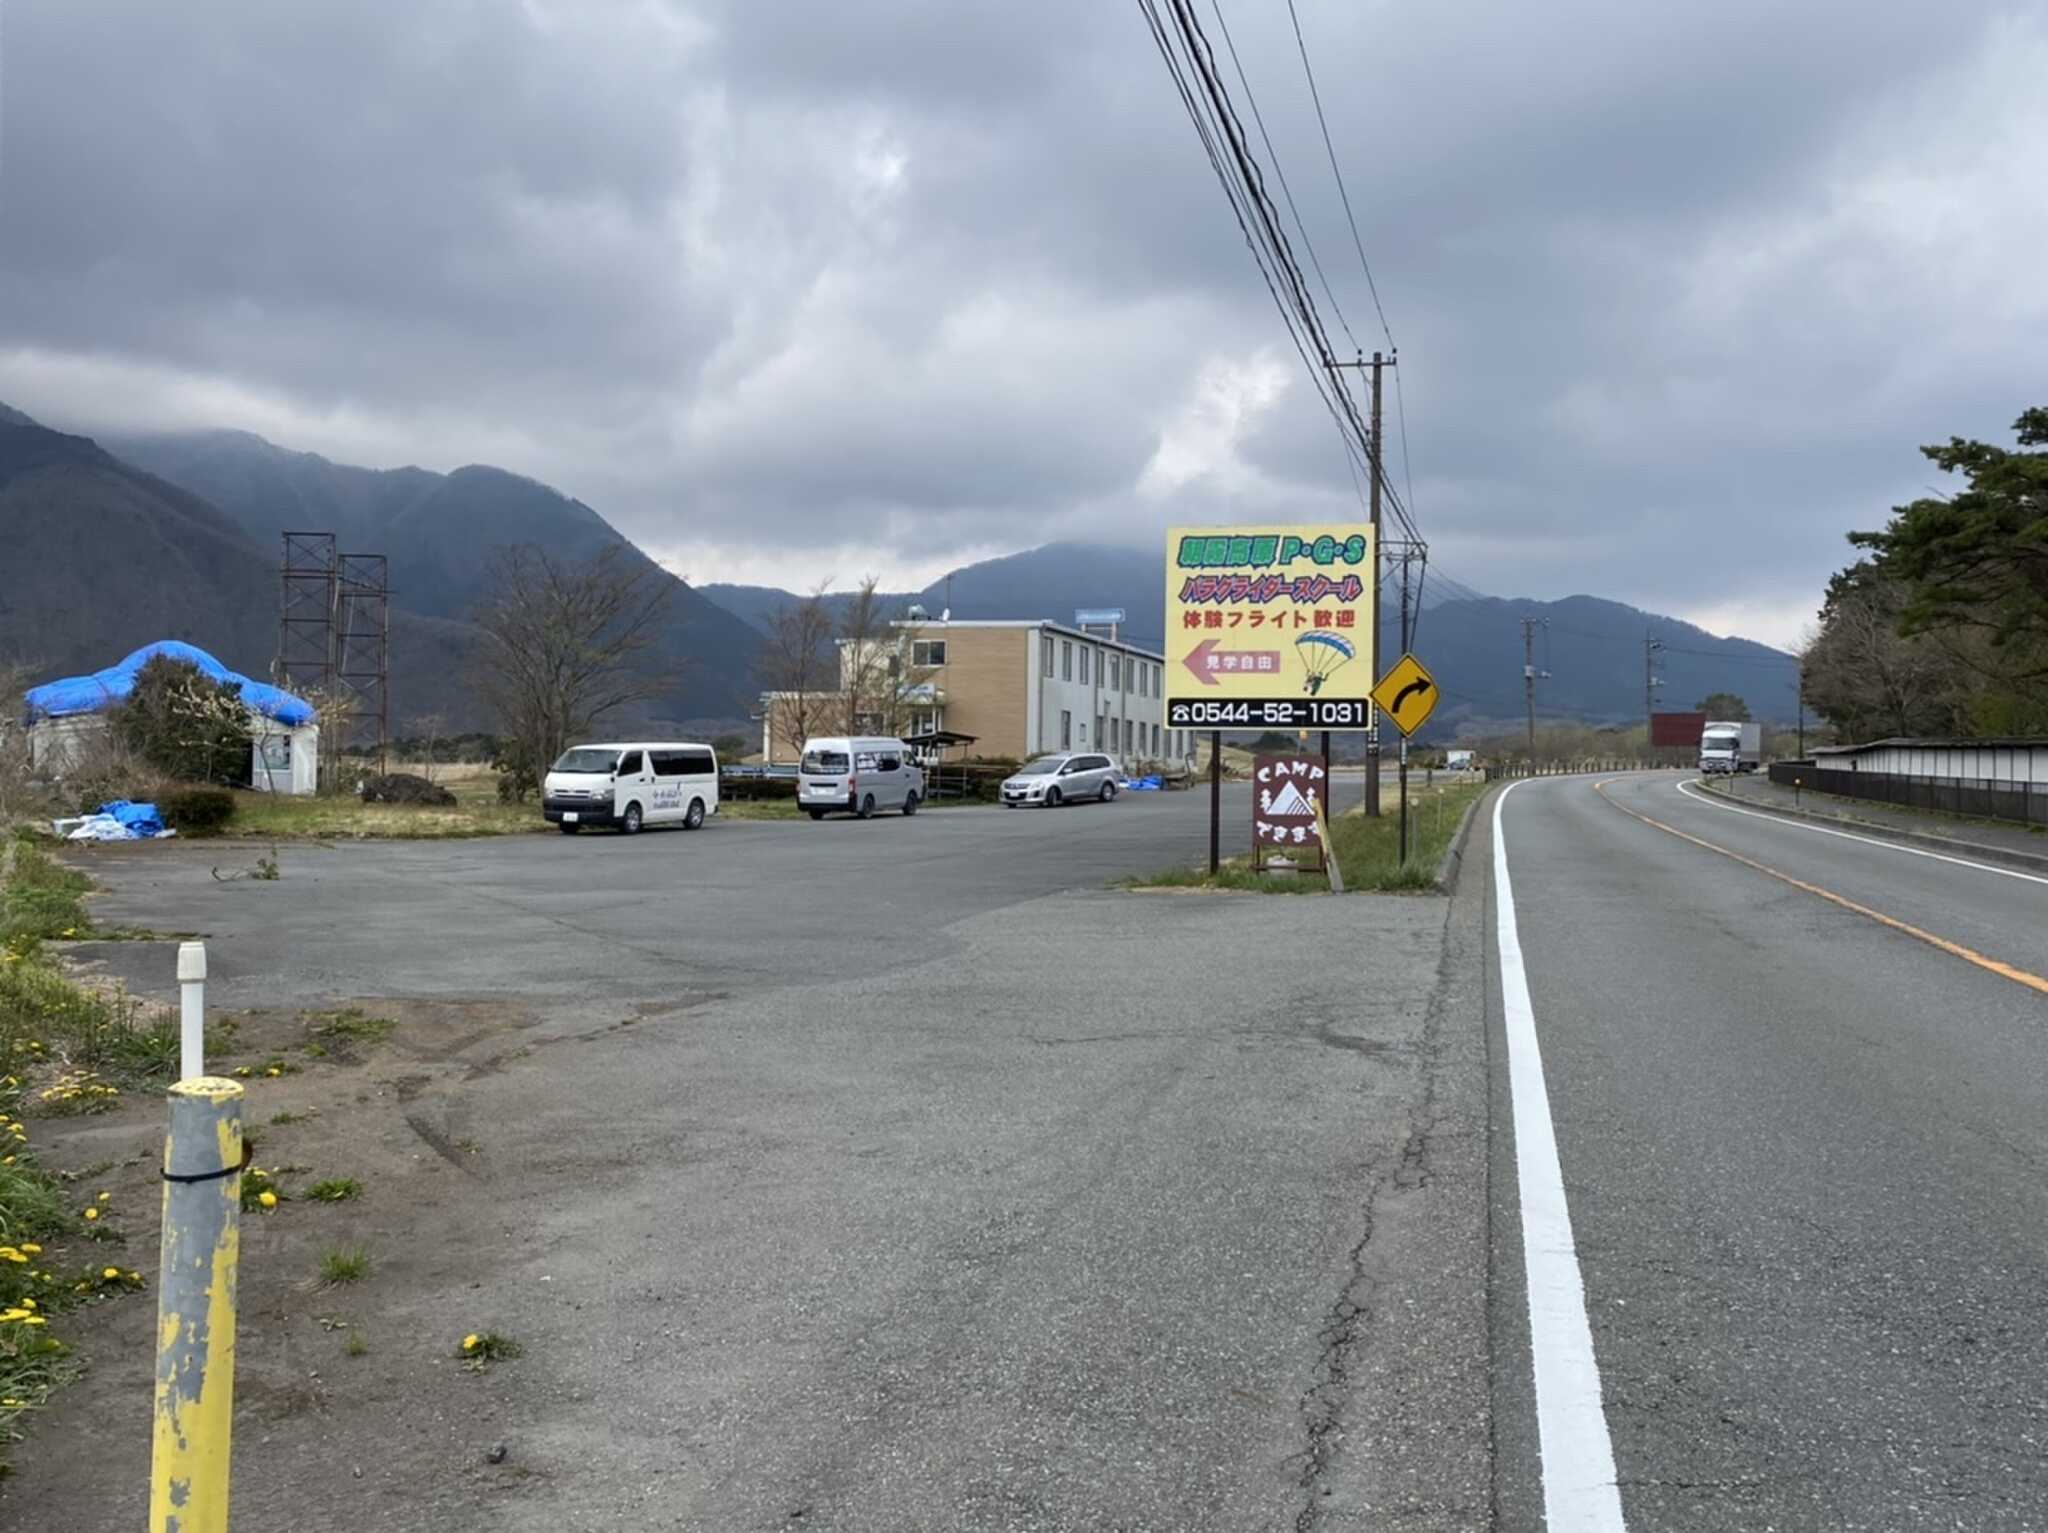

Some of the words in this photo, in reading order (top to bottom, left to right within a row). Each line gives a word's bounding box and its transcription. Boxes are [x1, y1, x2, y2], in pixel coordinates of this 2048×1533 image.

[1206, 654, 1273, 670] 見学自由
[1191, 703, 1363, 722] 0544-52-1031
[1257, 760, 1325, 783] CAMP
